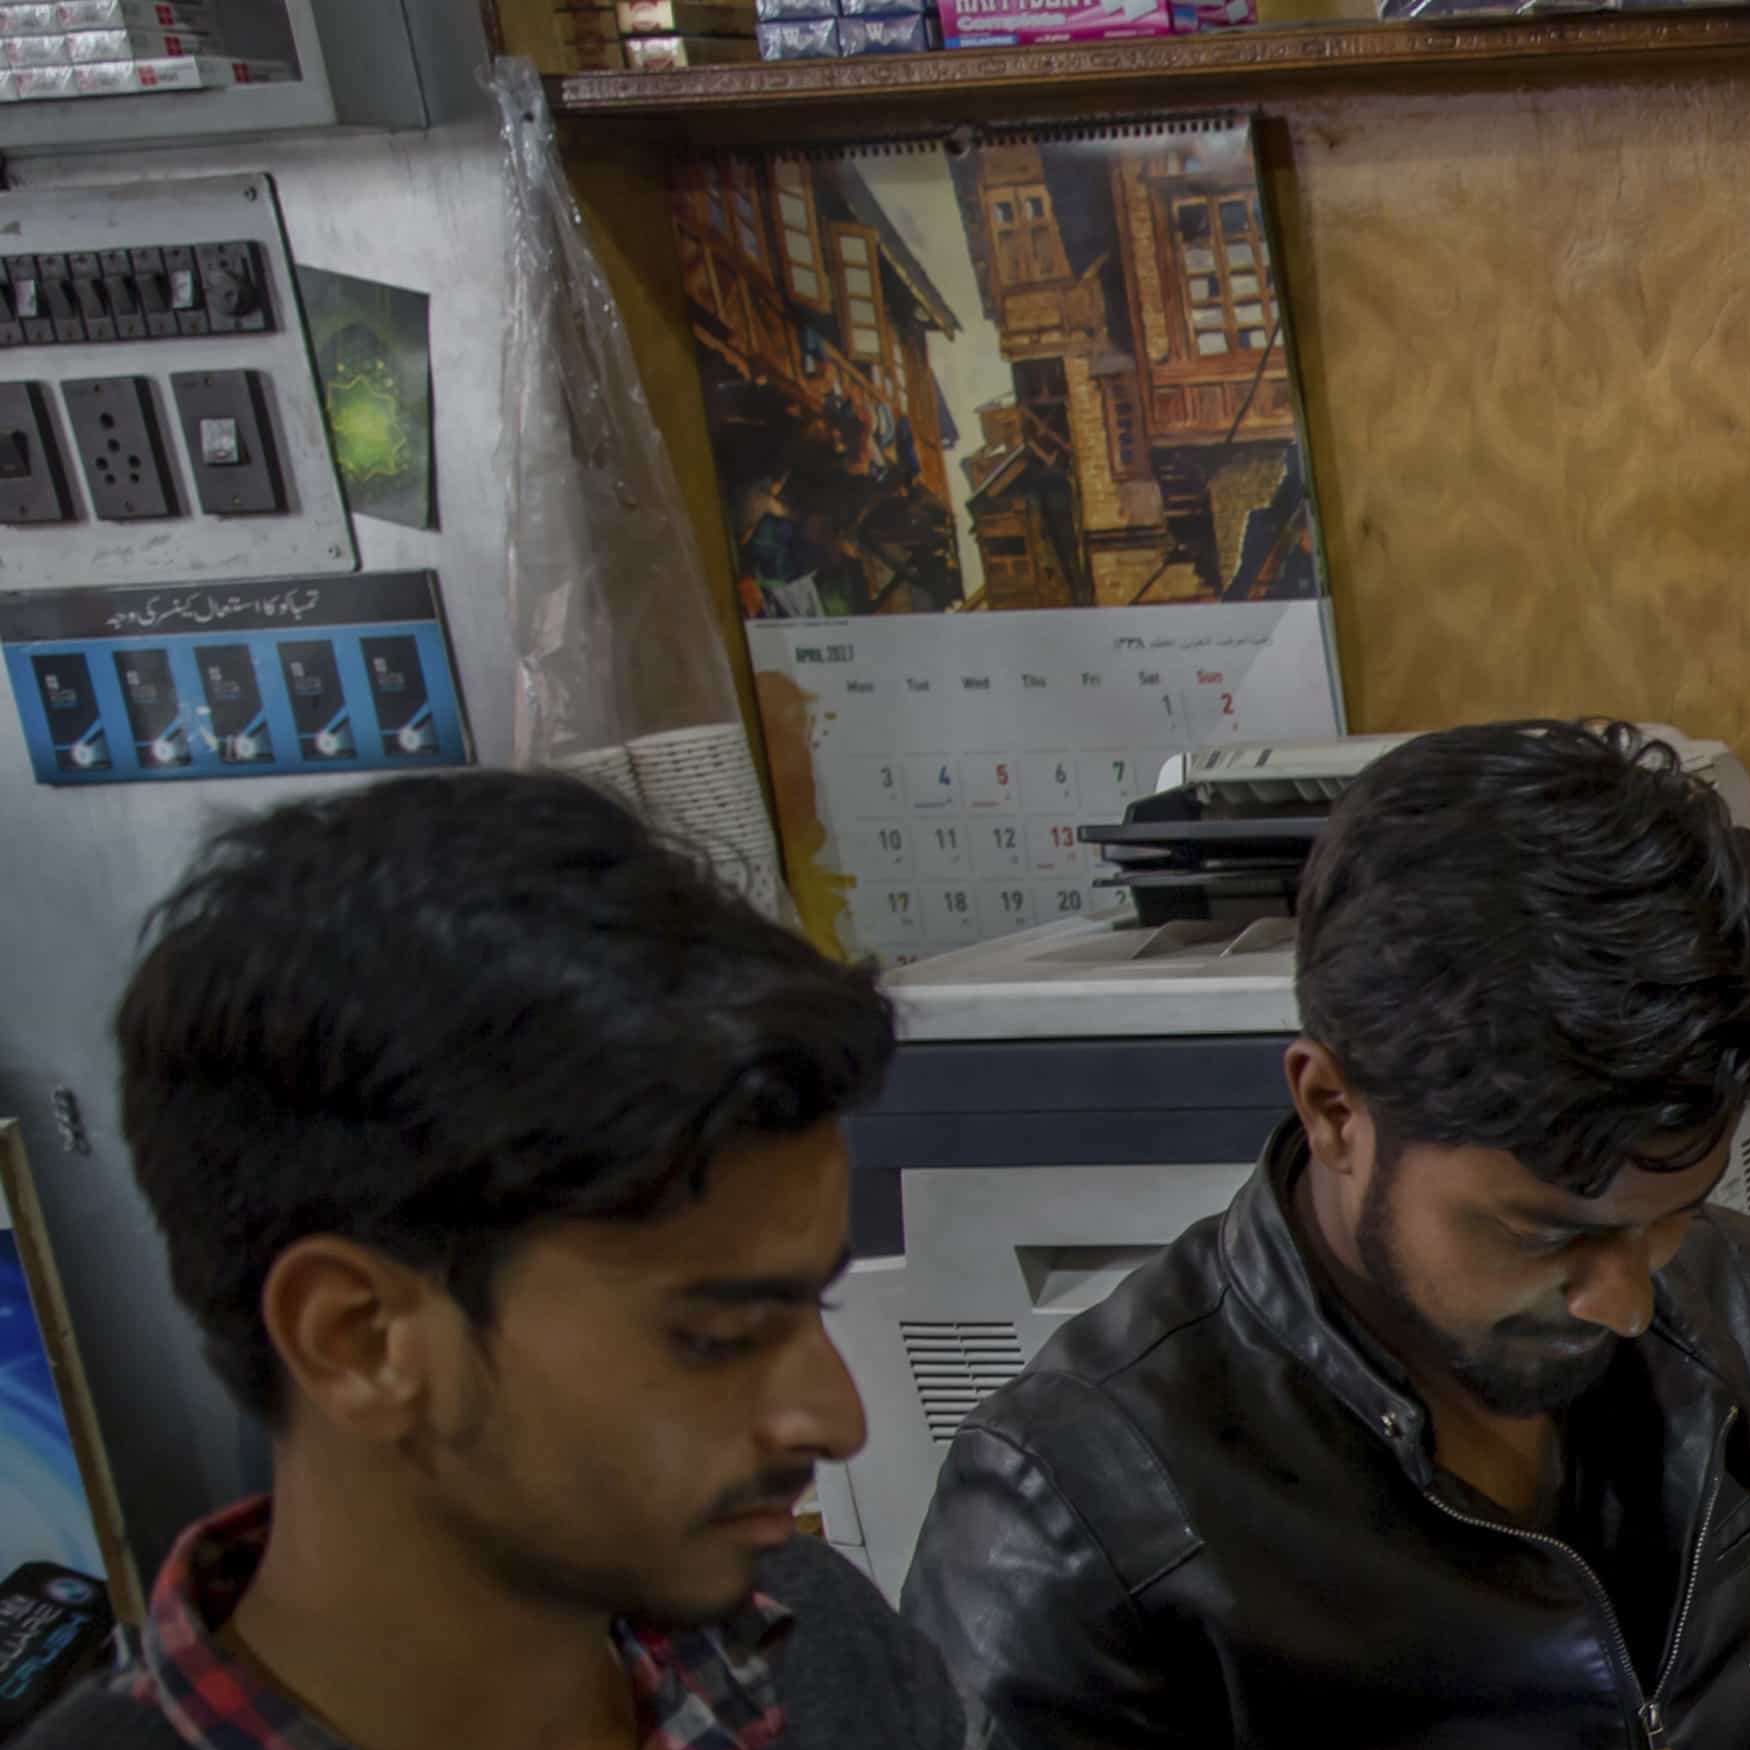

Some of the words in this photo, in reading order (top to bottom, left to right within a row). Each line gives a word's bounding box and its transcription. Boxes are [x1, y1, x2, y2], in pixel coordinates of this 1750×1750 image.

[193, 595, 261, 623] استعمال
[906, 677, 930, 692] Tue
[961, 675, 990, 689] Wed
[1081, 671, 1101, 687] Fri
[1139, 670, 1160, 686] Sat
[1196, 669, 1223, 684] Sun
[1162, 694, 1172, 715] 1
[1221, 692, 1234, 715] 2
[880, 766, 893, 788] 3
[938, 765, 950, 785] 4
[996, 763, 1009, 785] 5
[1055, 763, 1067, 784] 6
[1113, 761, 1125, 782] 7
[880, 829, 902, 850] 10
[936, 828, 957, 849] 11
[993, 827, 1016, 848] 12
[1051, 826, 1075, 848] 13
[888, 892, 909, 913] 17
[944, 891, 968, 912] 18
[1001, 890, 1023, 911] 19
[1057, 890, 1081, 911] 20
